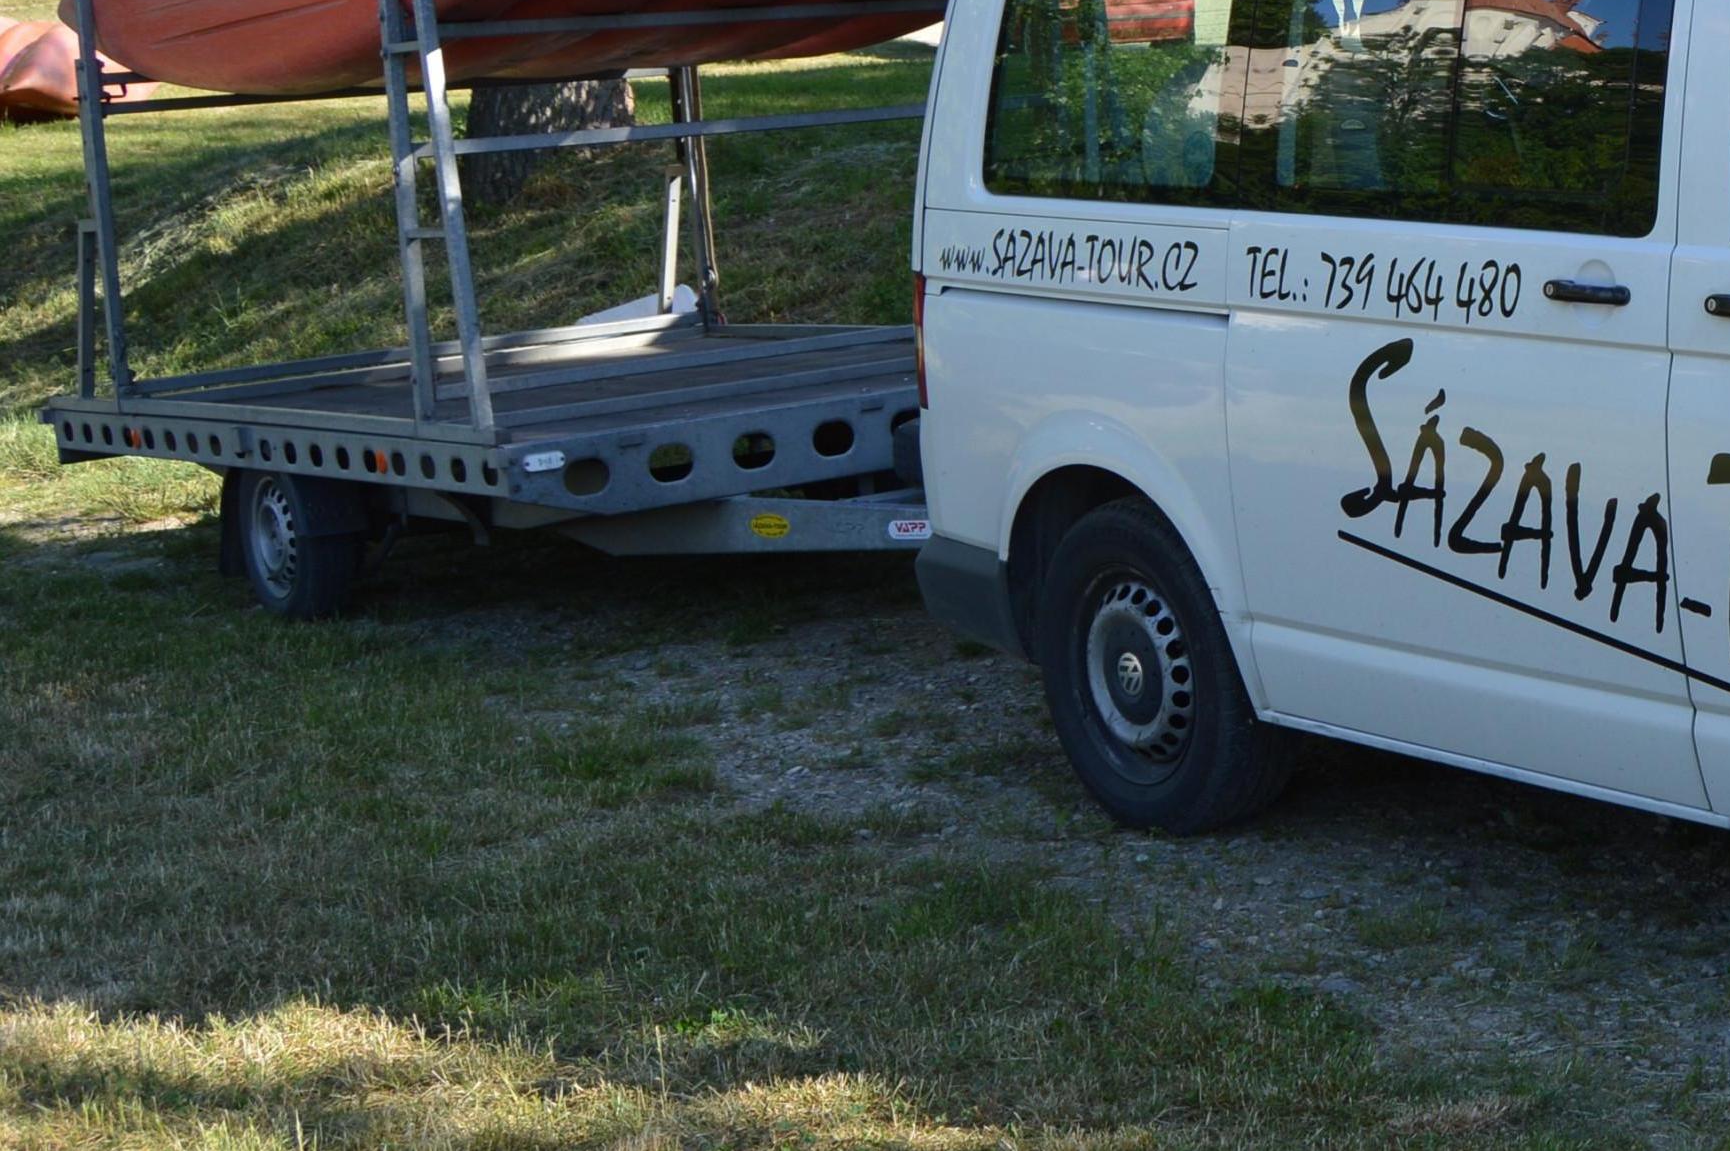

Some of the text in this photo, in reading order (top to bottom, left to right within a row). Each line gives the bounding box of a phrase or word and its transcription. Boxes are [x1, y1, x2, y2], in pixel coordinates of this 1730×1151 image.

[1246, 245, 1522, 325] TEL.: 739 464 480
